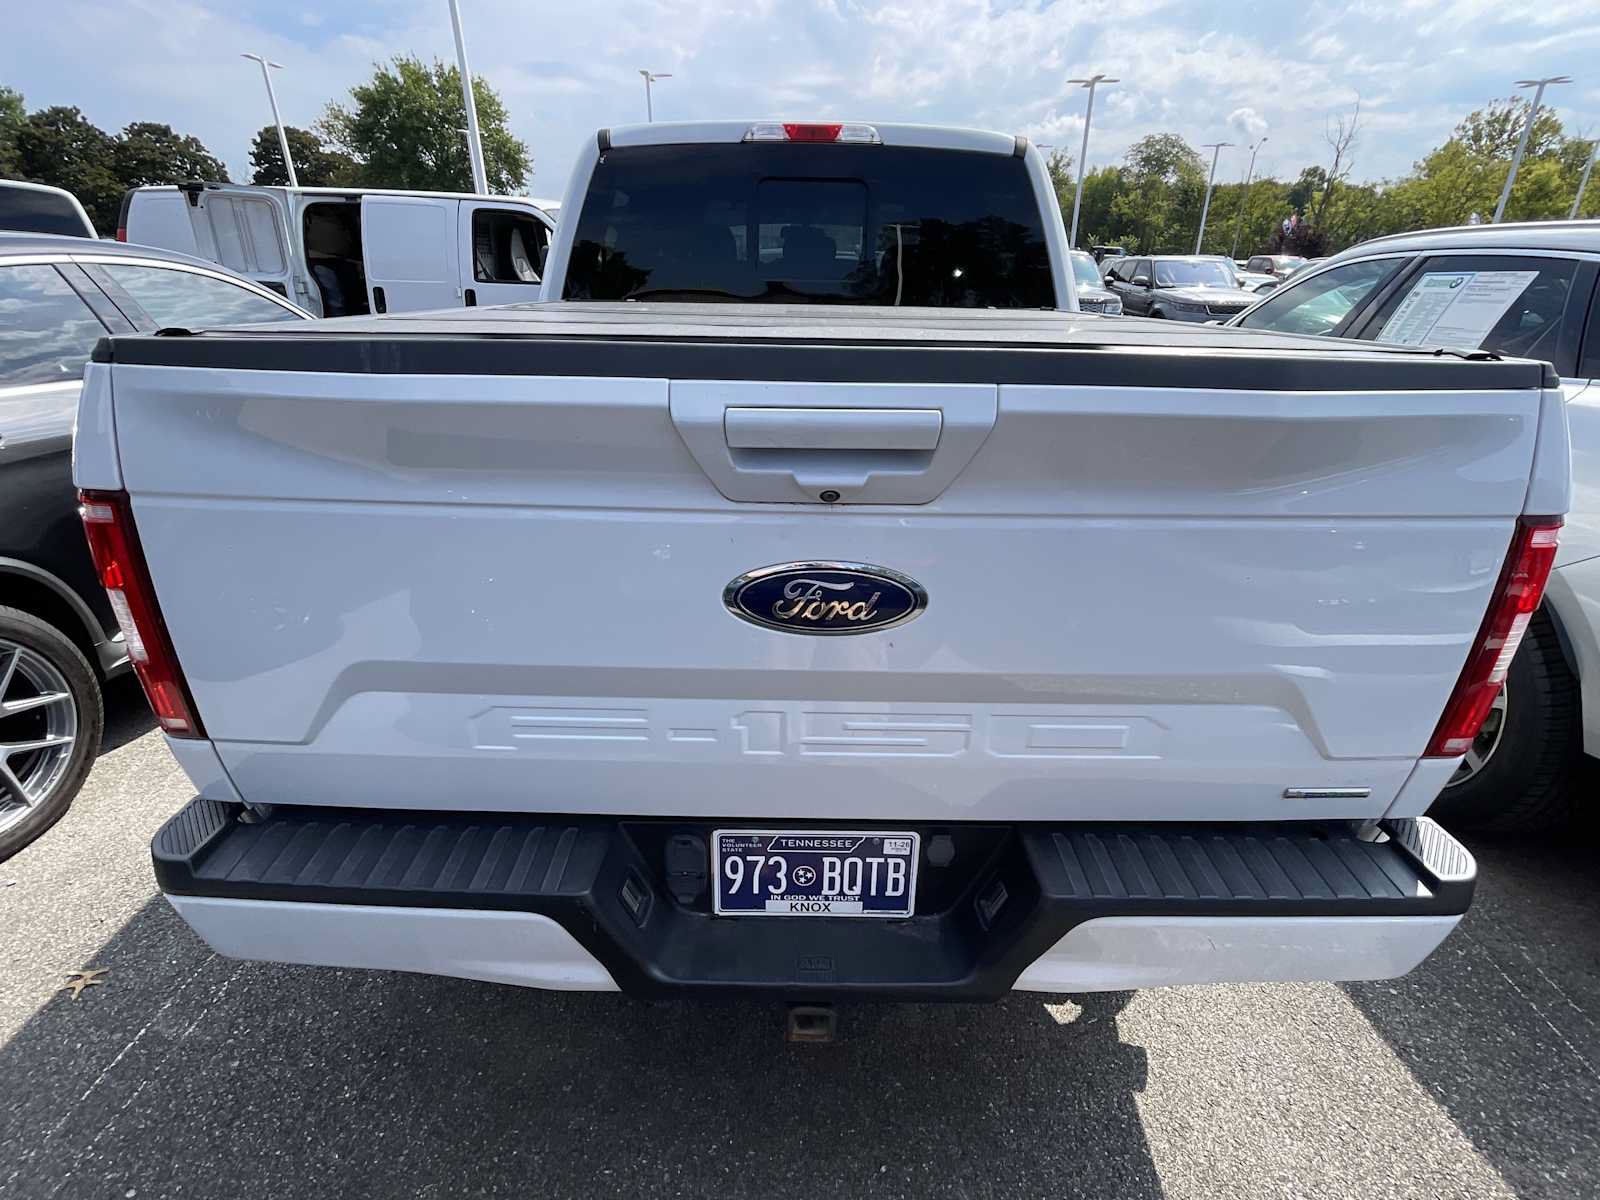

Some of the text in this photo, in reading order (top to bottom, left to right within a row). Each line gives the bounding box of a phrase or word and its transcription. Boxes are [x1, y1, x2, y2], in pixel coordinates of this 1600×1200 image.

[771, 578, 881, 621] Ford
[468, 704, 1171, 759] F-150
[780, 839, 853, 848] TENNESSEE
[724, 855, 906, 897] 973 BQTB
[790, 902, 831, 912] KNOX
